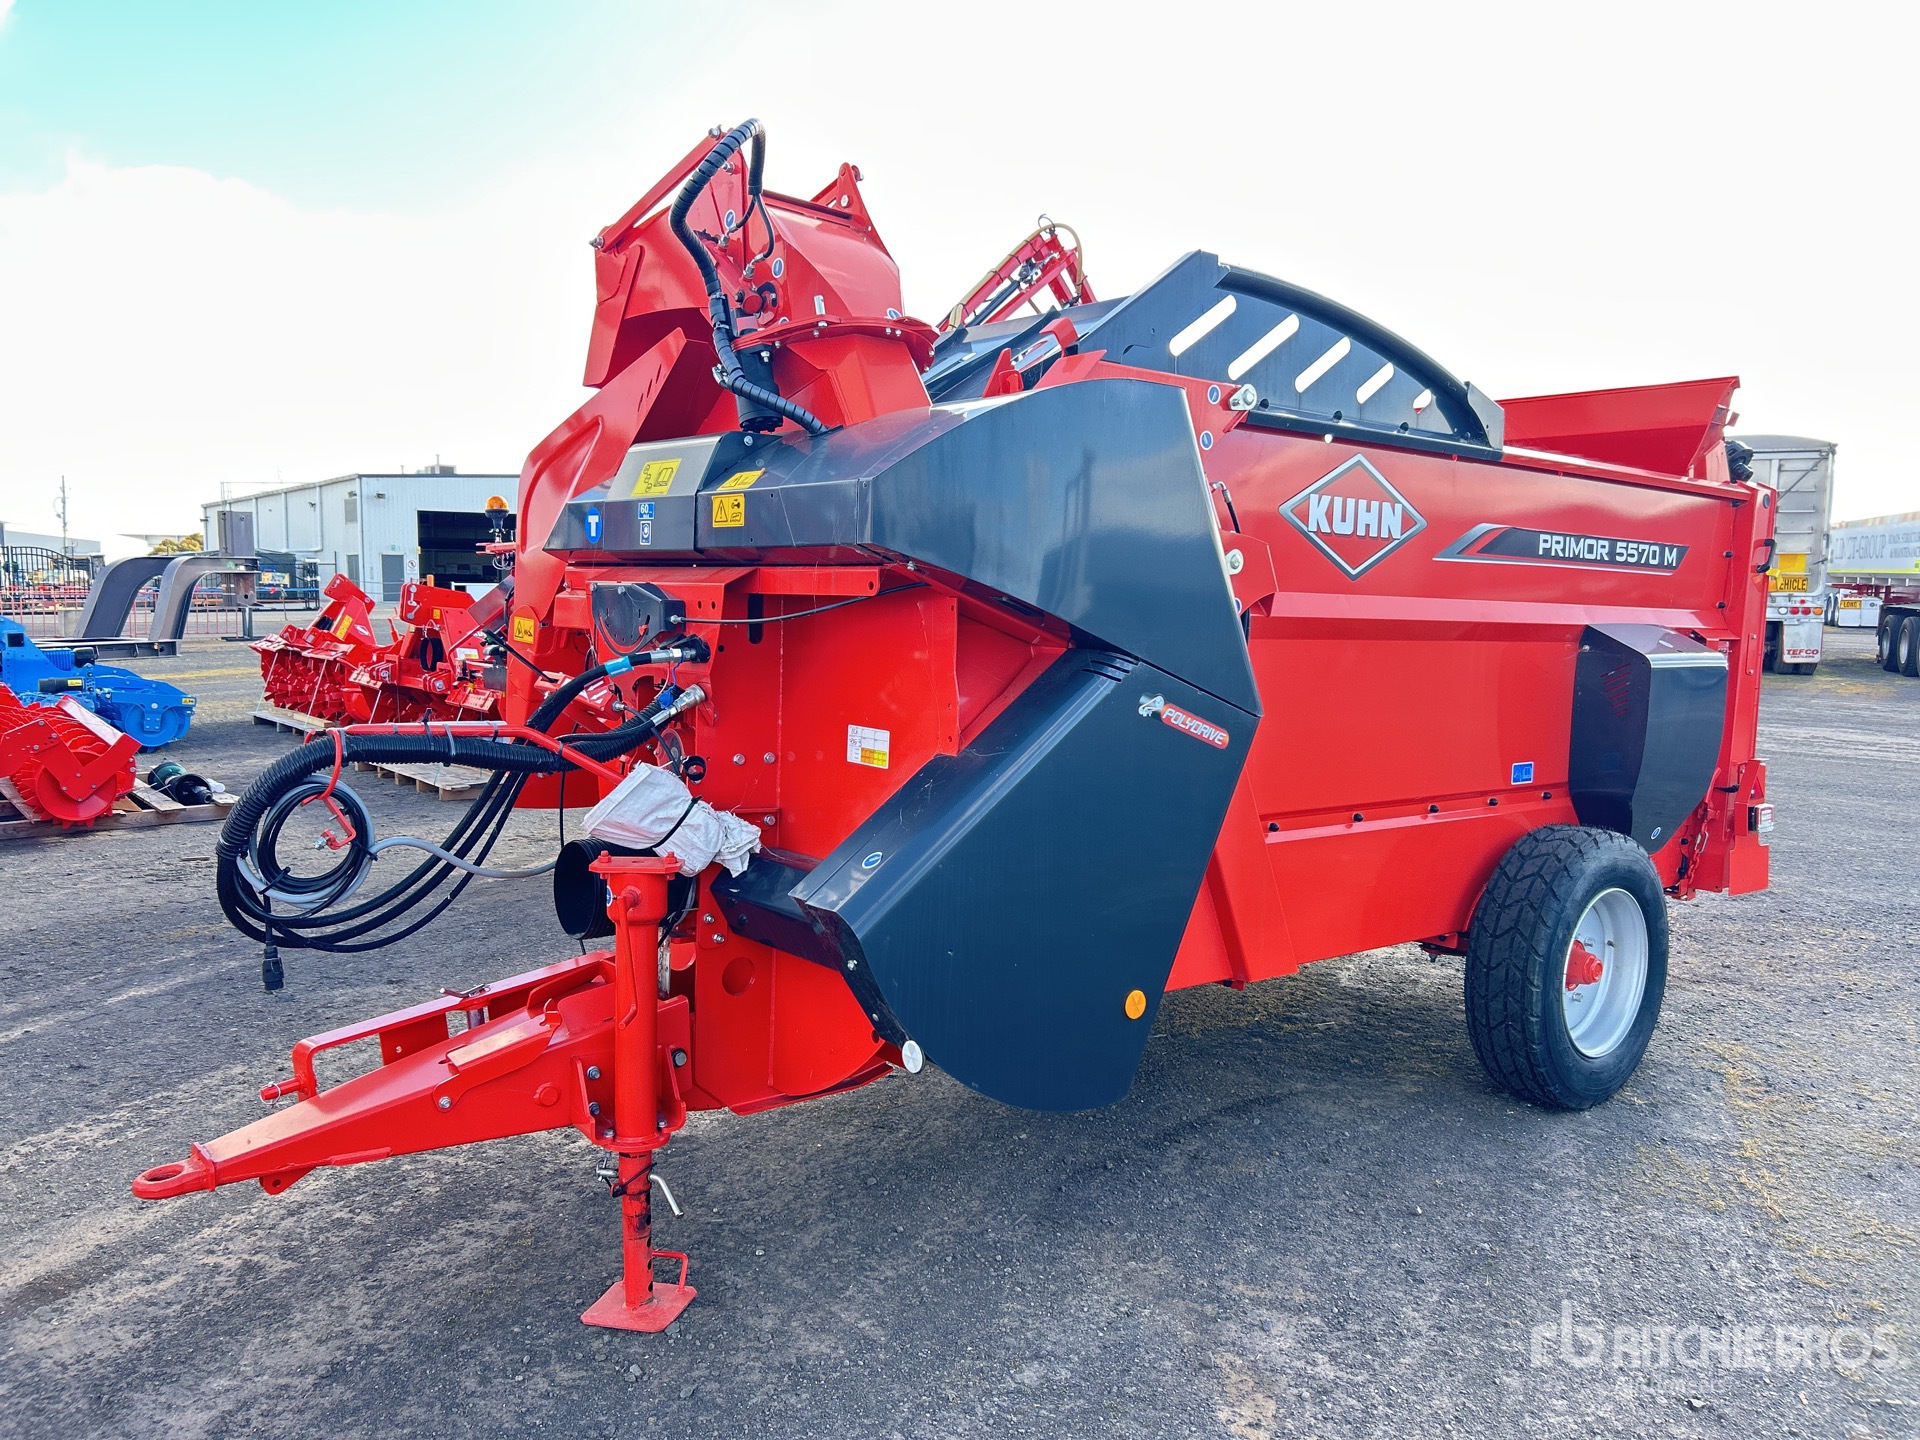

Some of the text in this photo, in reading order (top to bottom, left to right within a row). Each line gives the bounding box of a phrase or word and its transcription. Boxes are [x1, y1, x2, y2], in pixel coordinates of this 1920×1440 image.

[1307, 493, 1403, 539] KUHN
[1538, 534, 1677, 567] PRIMOR 5570 M
[1779, 577, 1807, 591] EHICLE
[1162, 707, 1227, 745] POLYDRIVE
